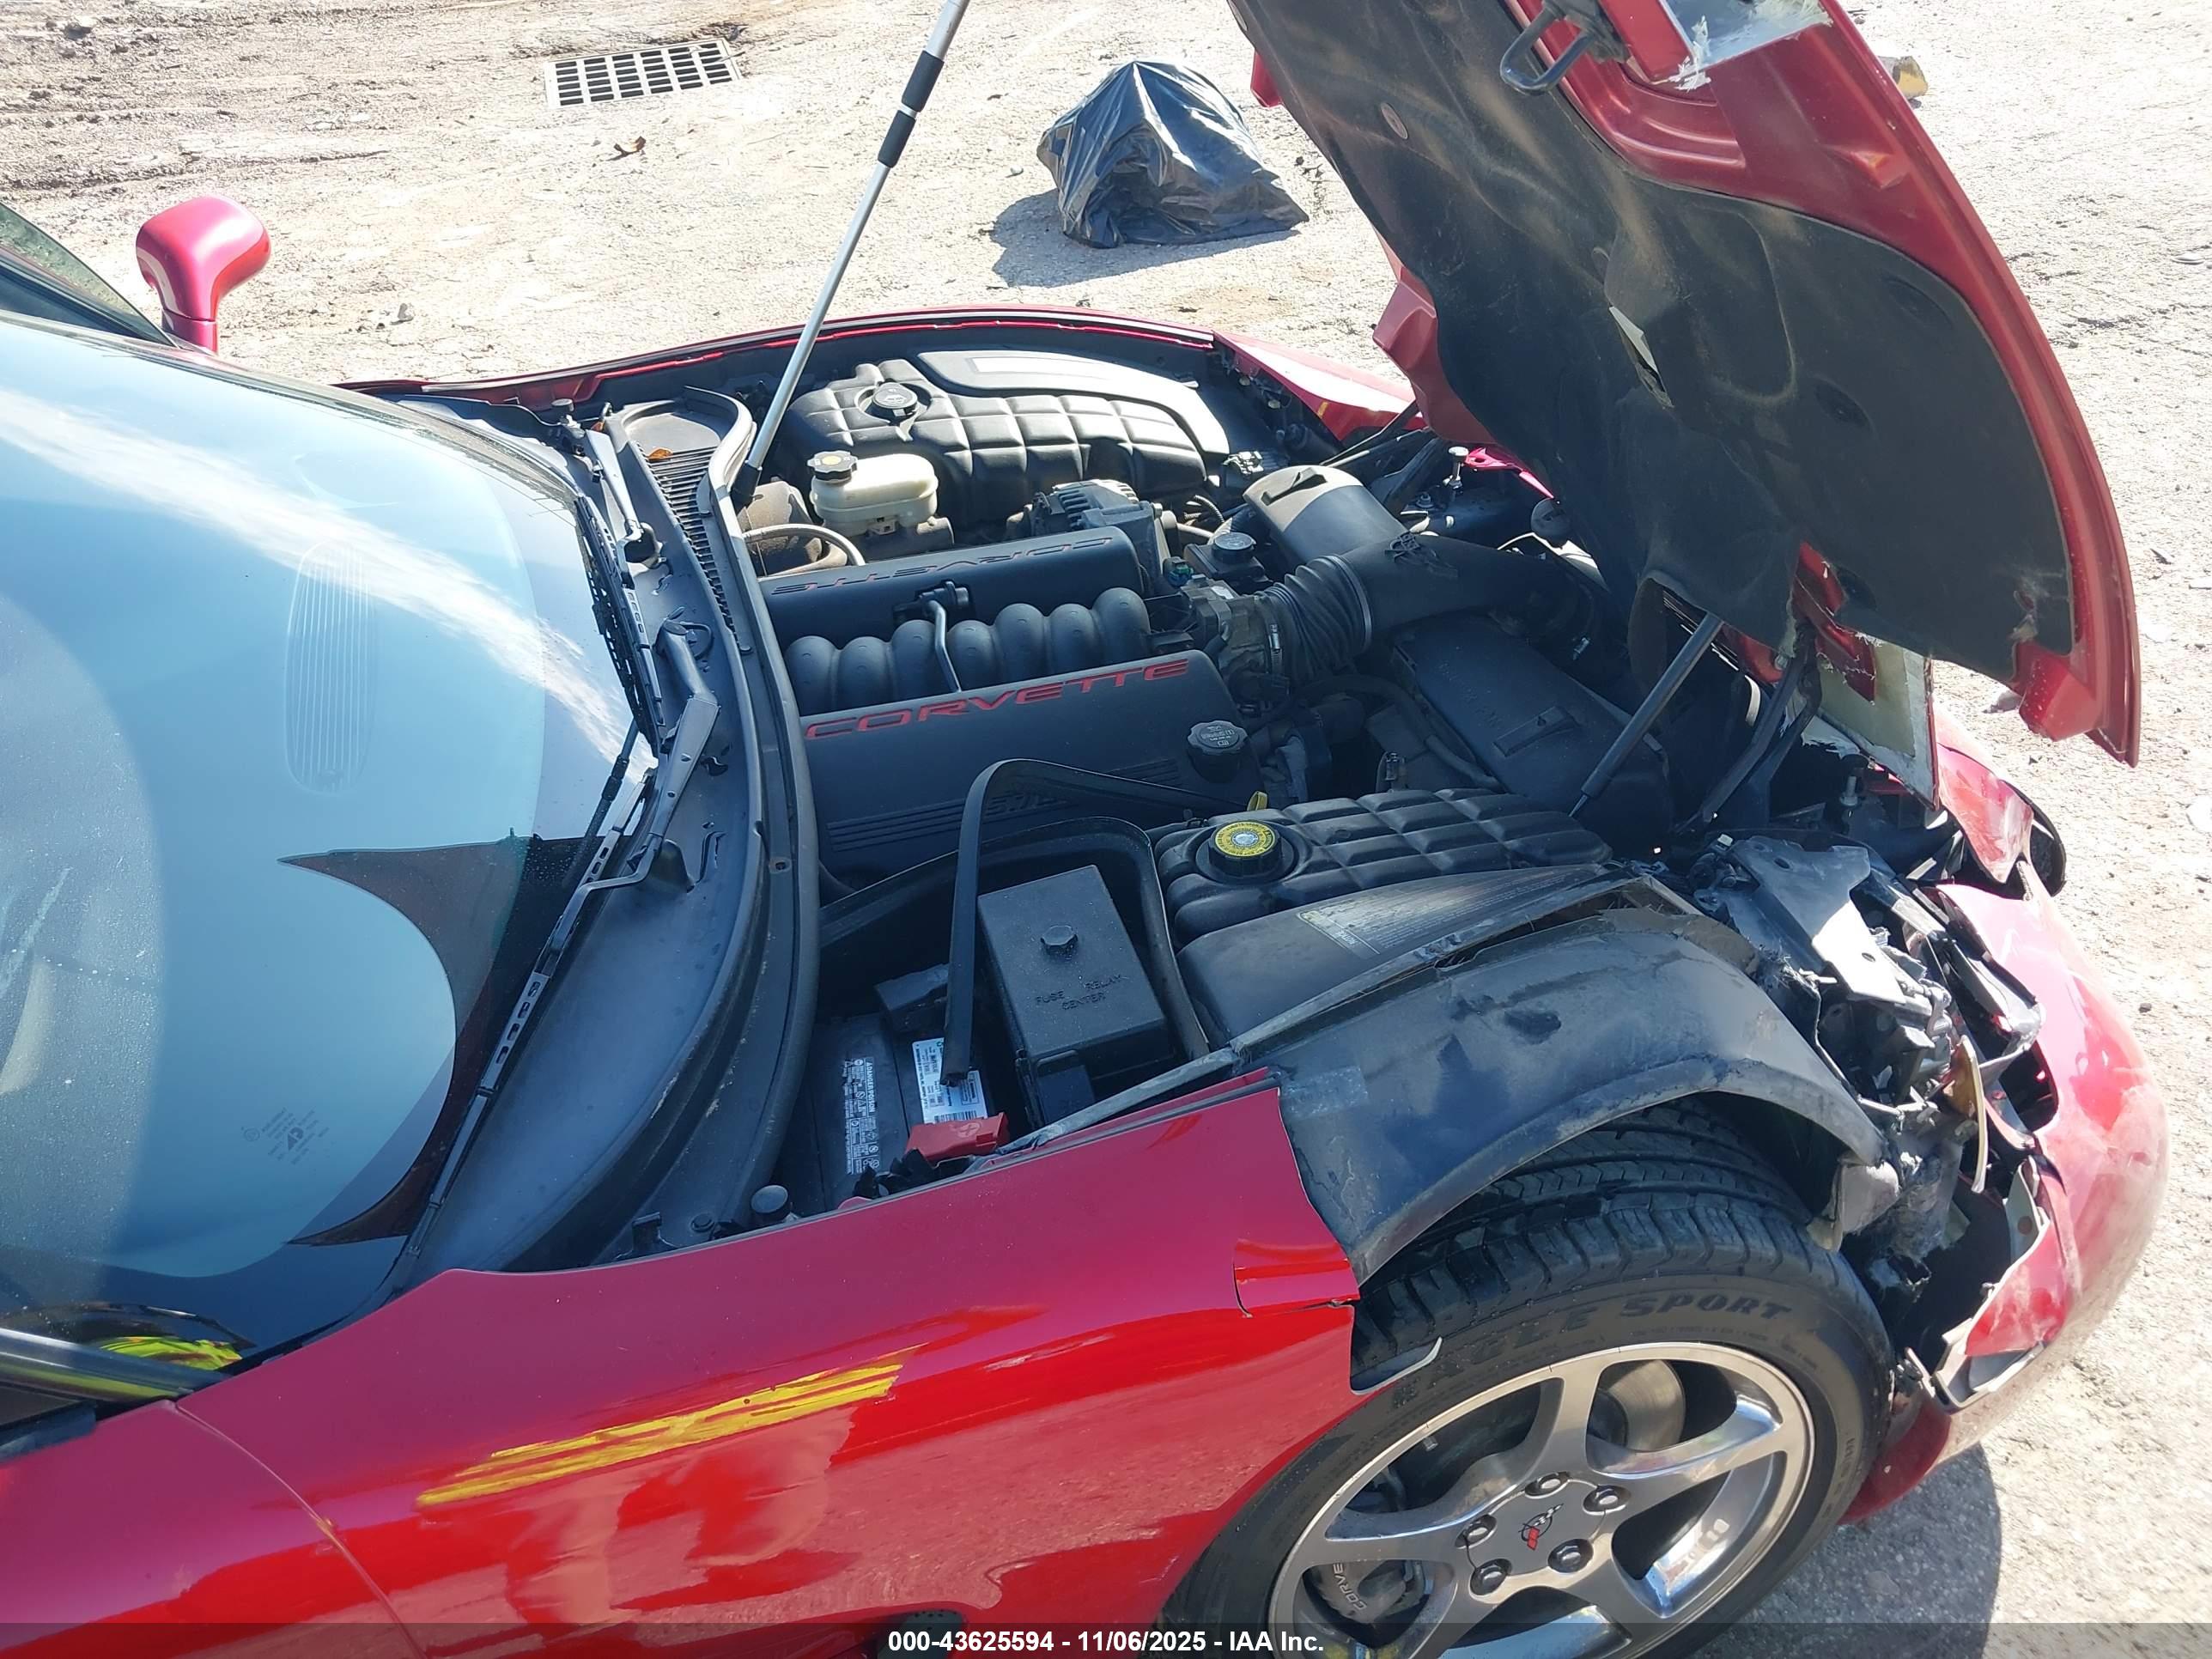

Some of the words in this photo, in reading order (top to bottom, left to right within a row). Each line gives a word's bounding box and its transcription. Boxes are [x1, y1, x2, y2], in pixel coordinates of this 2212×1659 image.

[771, 537, 1113, 595] CORVETTE
[805, 659, 1188, 740] CORVETTE
[1036, 989, 1066, 1004] FUSE
[1085, 974, 1122, 990] RELAY
[1061, 992, 1106, 1011] CENTER
[1620, 1292, 1792, 1320] SPORT
